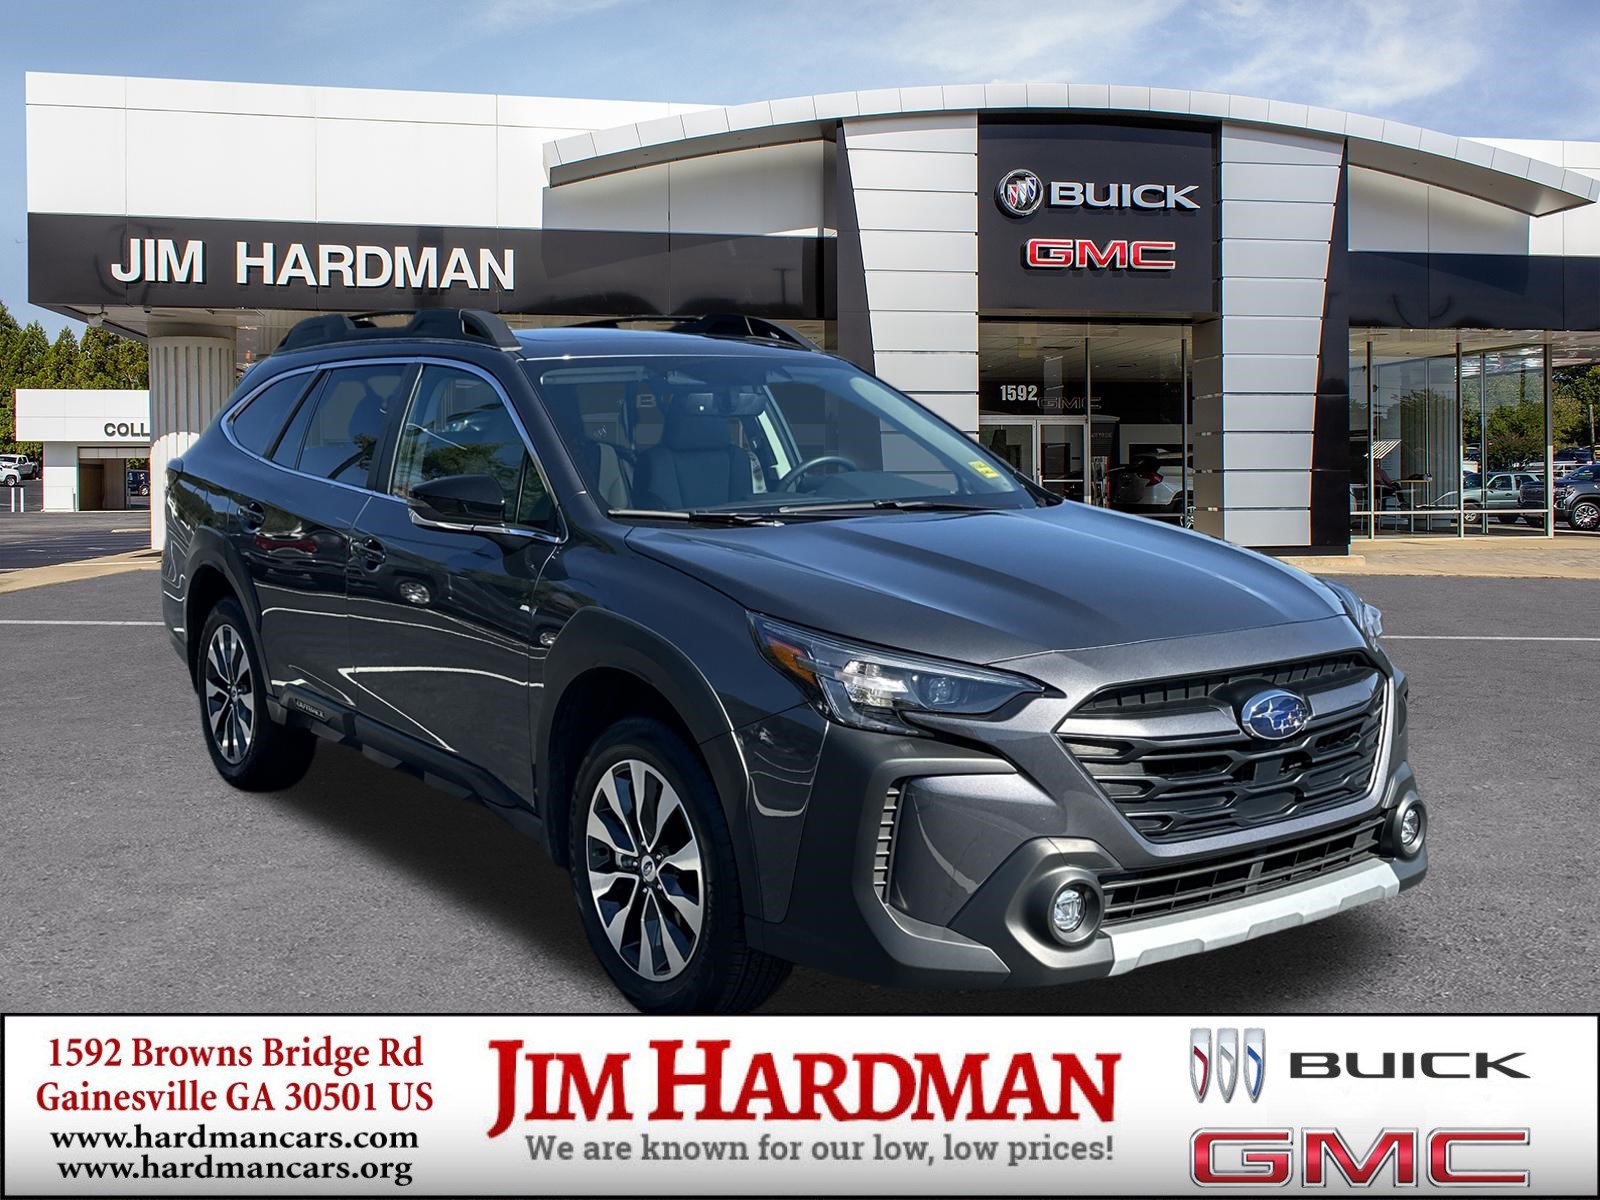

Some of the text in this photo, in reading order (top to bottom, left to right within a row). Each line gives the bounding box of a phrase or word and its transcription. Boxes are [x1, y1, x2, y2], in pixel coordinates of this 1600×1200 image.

[1050, 181, 1200, 209] BUICK
[111, 238, 515, 290] JIM HARDMAN
[1025, 238, 1176, 270] GMC
[1000, 385, 1037, 401] 1592
